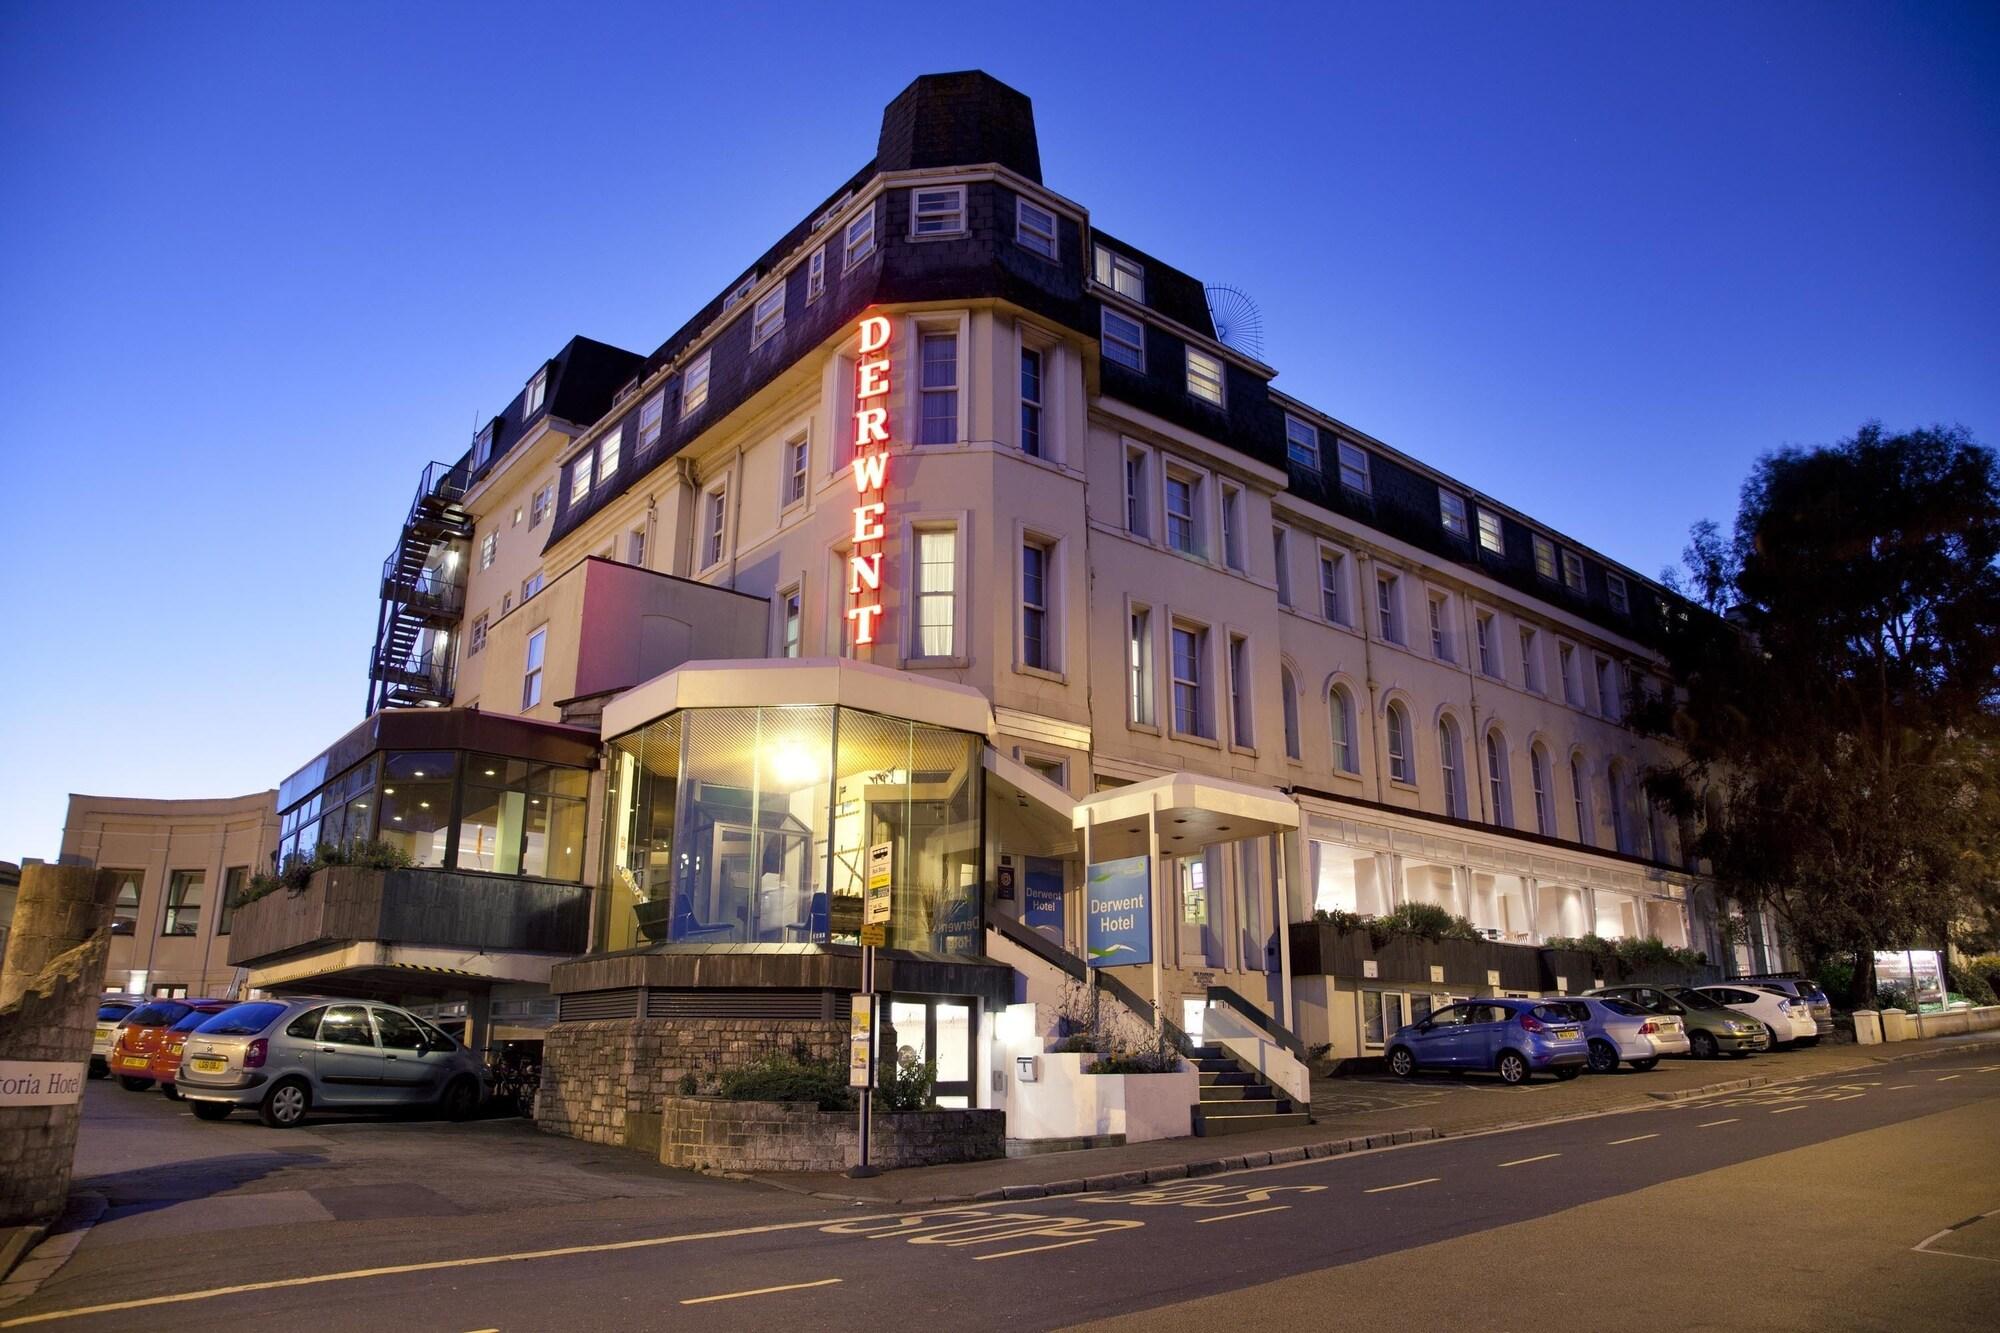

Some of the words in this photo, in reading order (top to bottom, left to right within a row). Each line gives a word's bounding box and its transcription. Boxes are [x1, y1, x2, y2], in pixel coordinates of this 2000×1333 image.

[848, 315, 892, 645] DERWENT
[1026, 887, 1062, 901] Derwent
[1091, 893, 1144, 914] Derwent
[1033, 900, 1056, 912] Hotel
[1101, 913, 1135, 933] Hotel
[1077, 1184, 1329, 1207] BUS
[818, 1211, 1146, 1247] STOP
